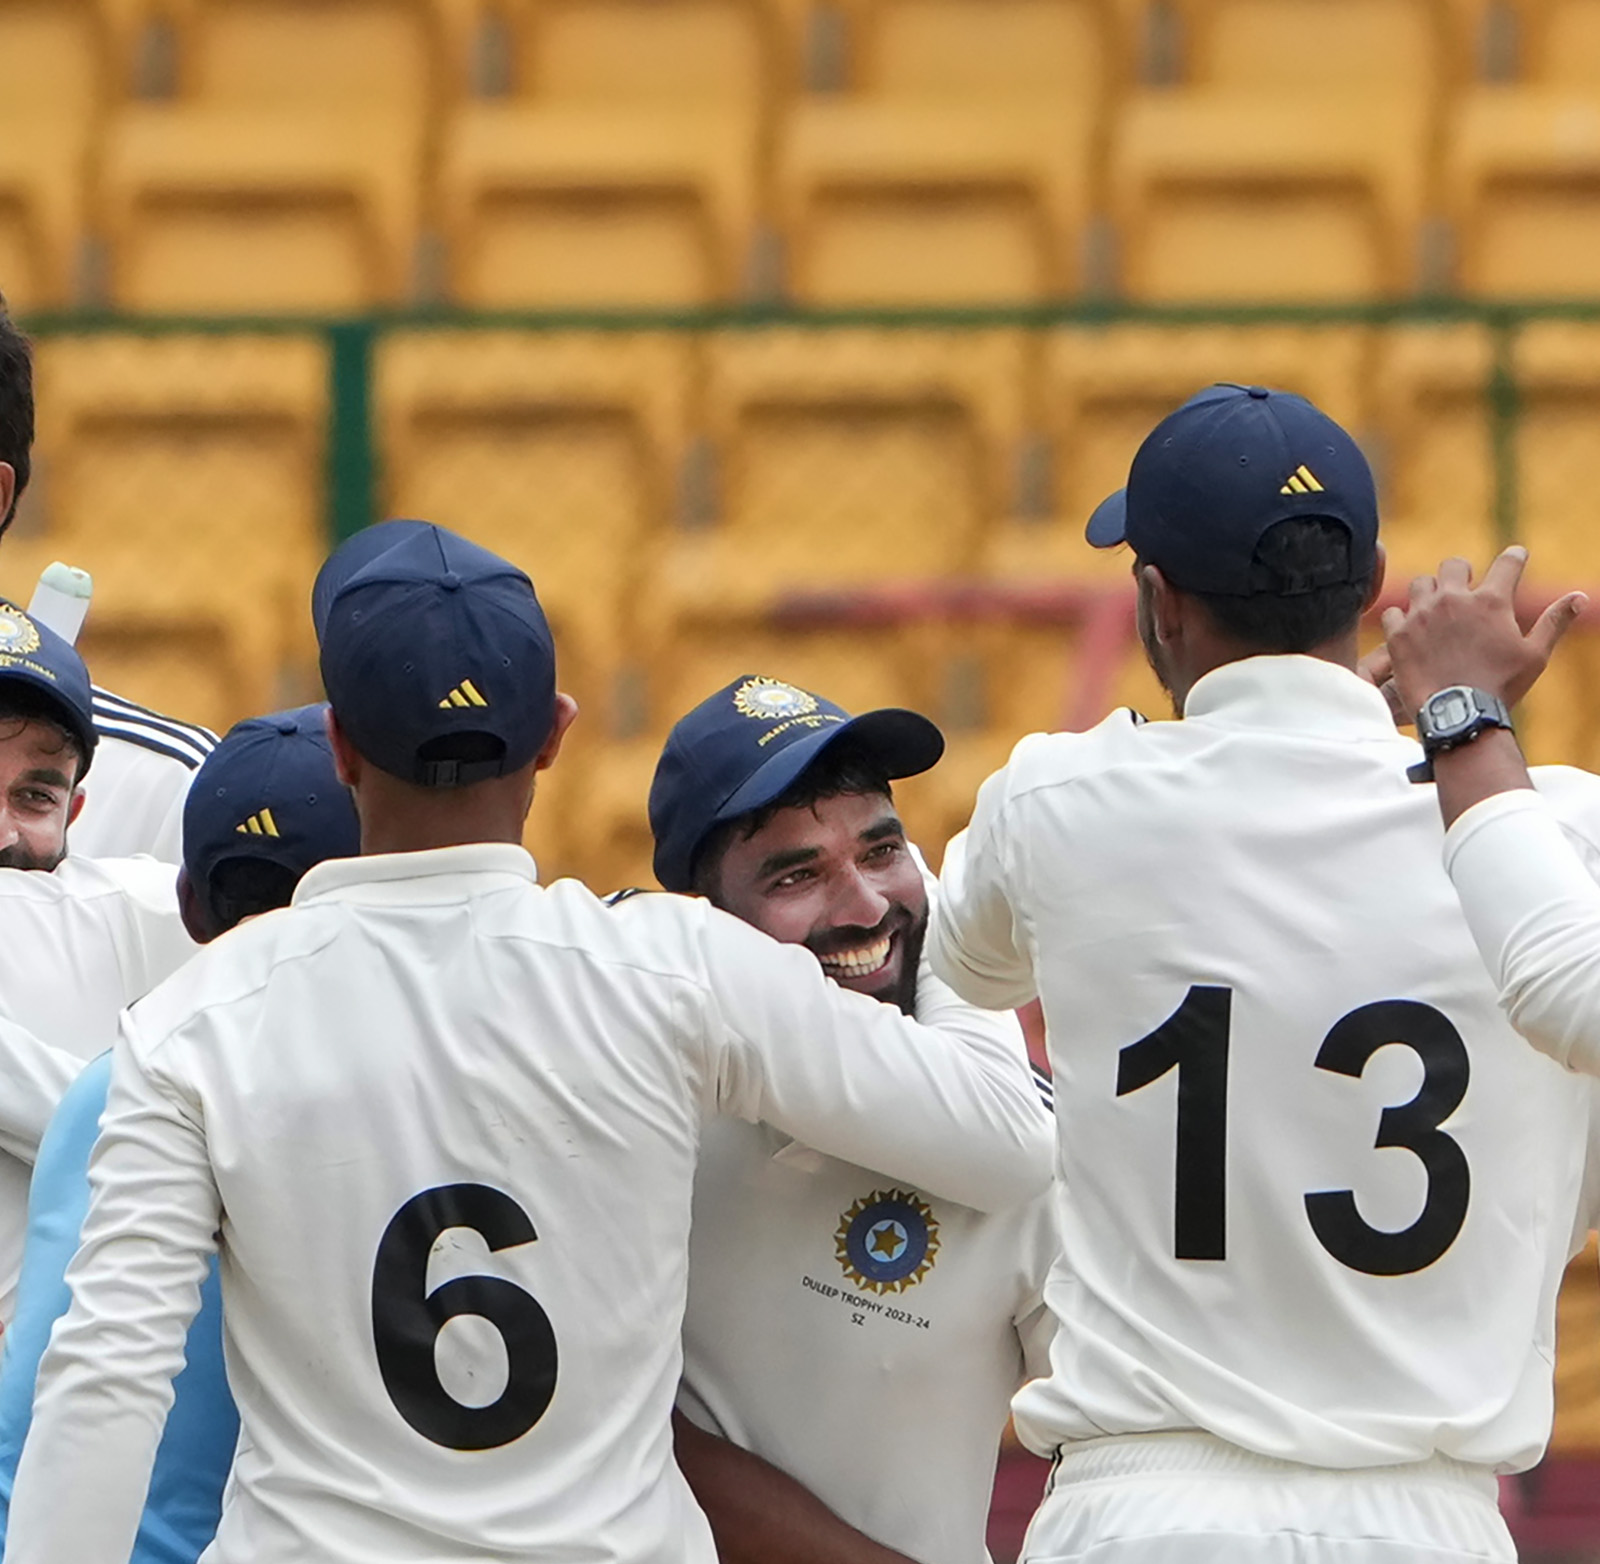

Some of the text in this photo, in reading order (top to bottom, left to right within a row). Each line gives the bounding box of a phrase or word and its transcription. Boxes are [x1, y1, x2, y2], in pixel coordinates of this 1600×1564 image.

[1116, 985, 1471, 1277] 13
[371, 1182, 559, 1452] 6
[802, 1275, 930, 1329] DULEEP TROPHY 2023-24
[851, 1312, 866, 1326] SZ
